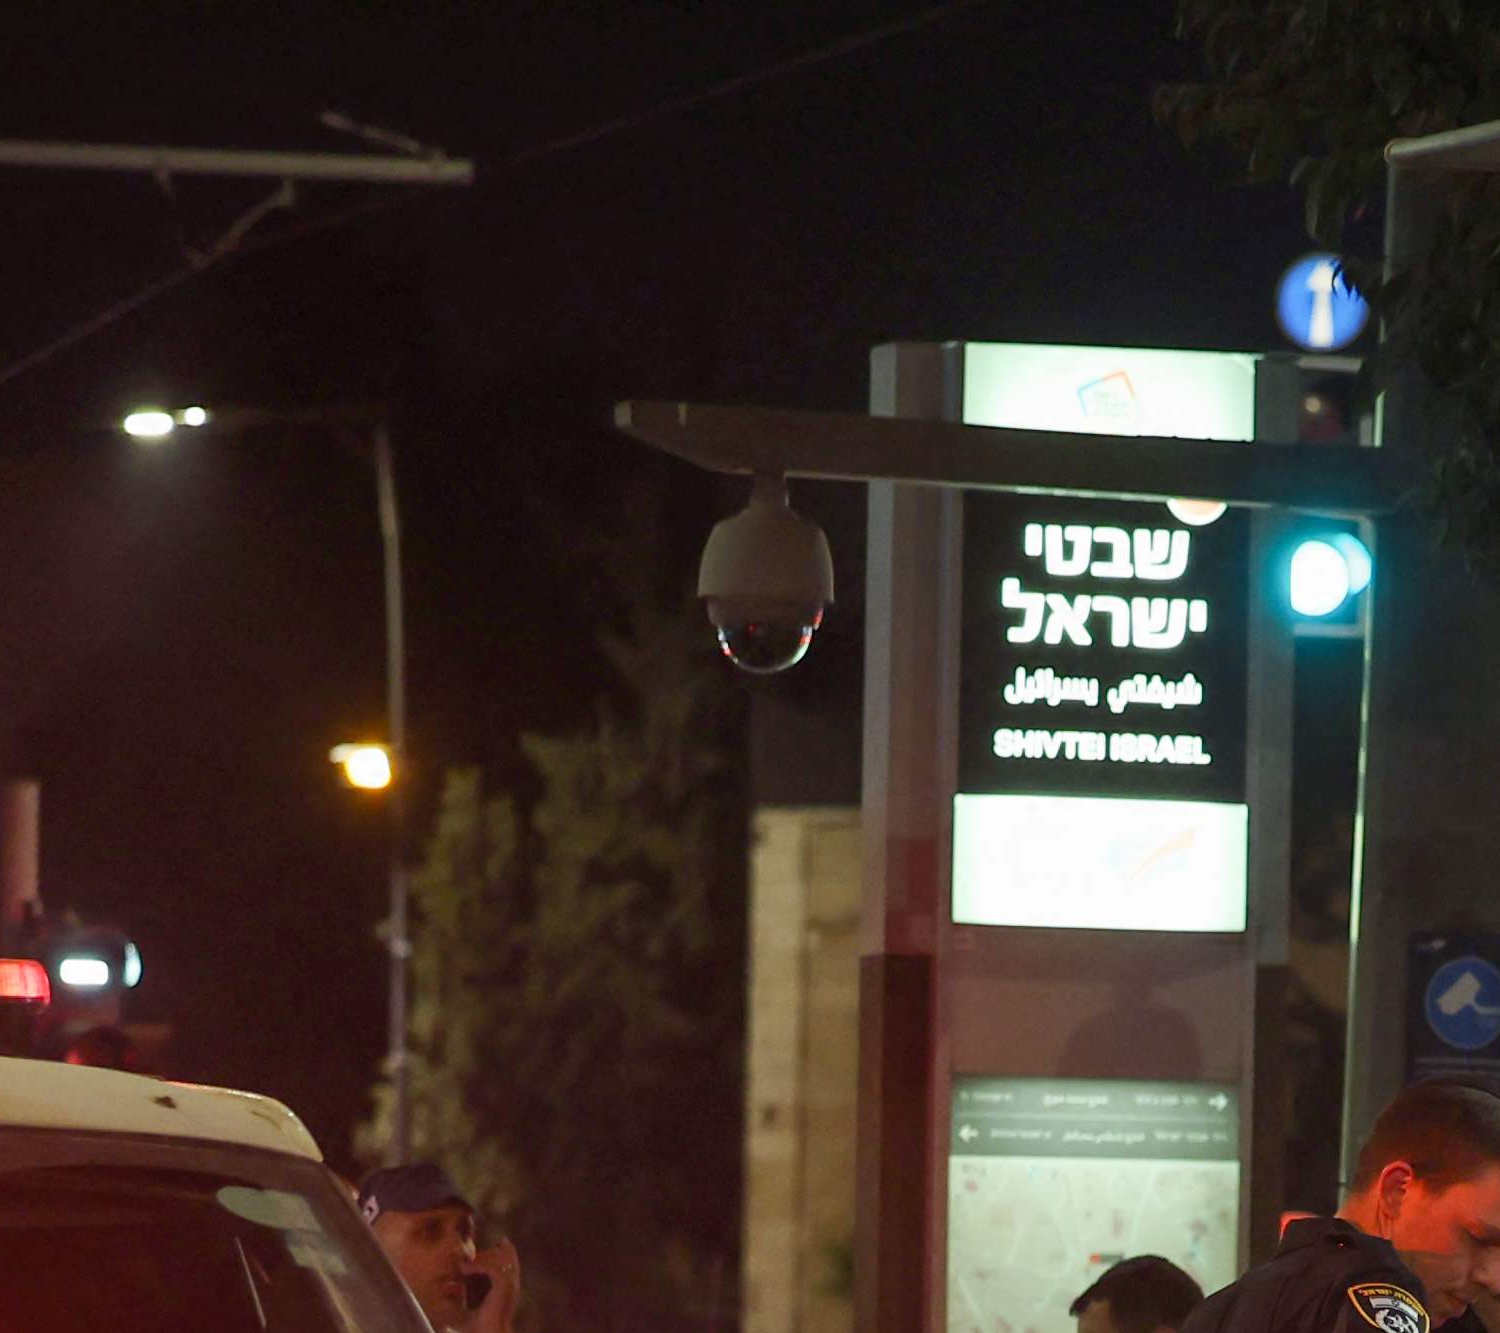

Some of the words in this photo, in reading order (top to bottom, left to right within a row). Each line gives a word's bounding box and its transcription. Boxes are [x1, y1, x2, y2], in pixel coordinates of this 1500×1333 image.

[1024, 522, 1190, 580] שבטי
[1001, 577, 1208, 650] ישראל
[993, 728, 1106, 761] SHIVTEI
[1109, 732, 1211, 764] ISRAEL
